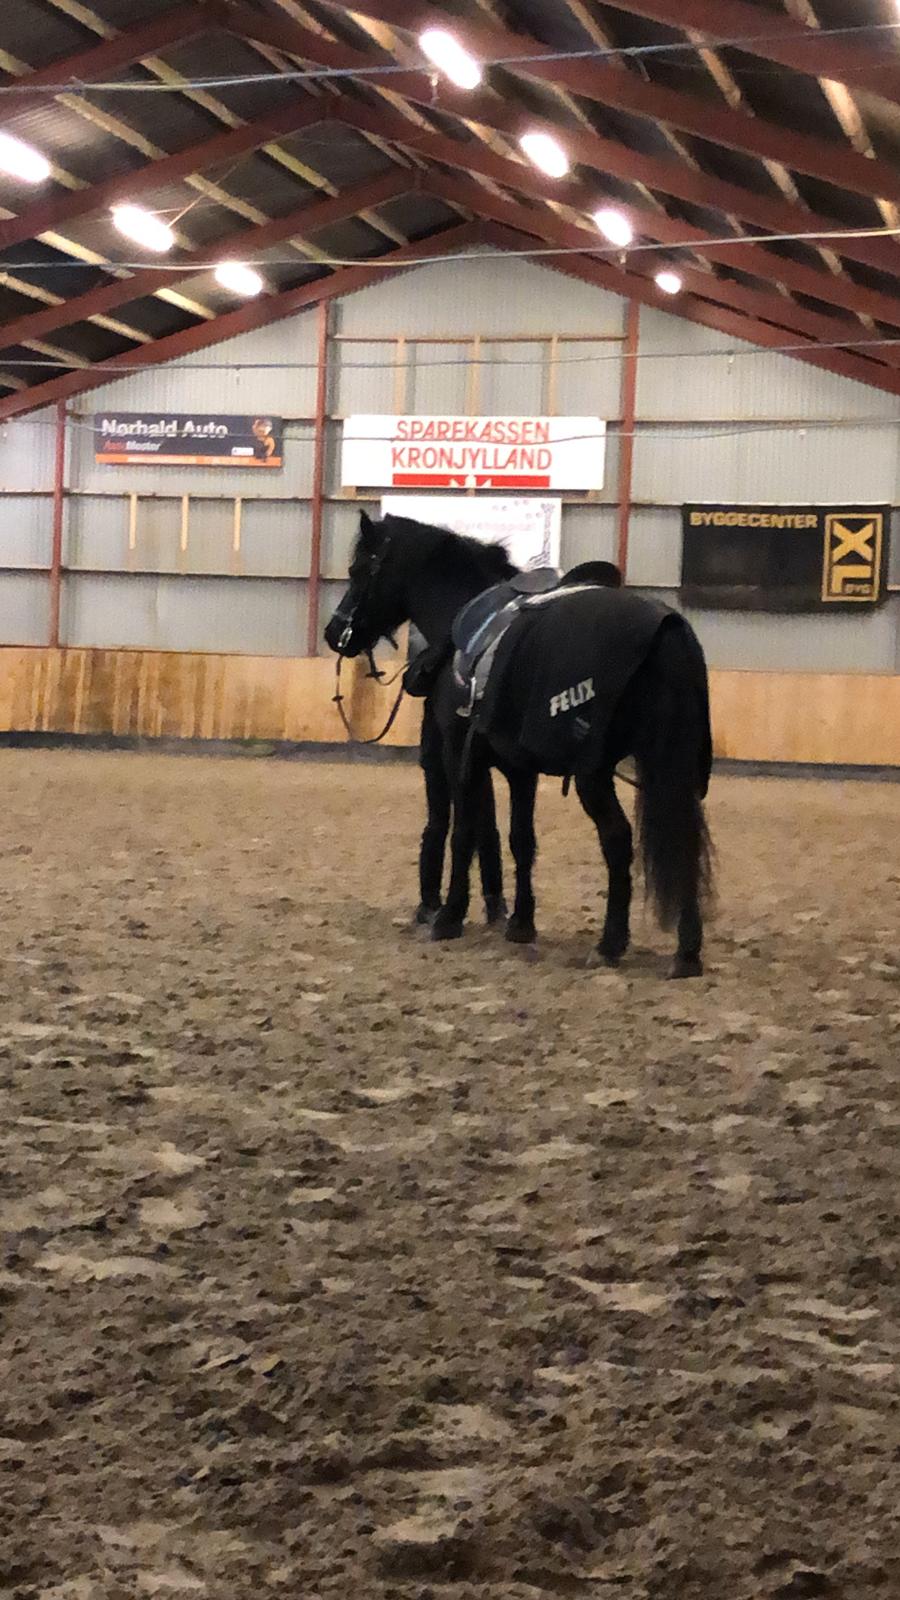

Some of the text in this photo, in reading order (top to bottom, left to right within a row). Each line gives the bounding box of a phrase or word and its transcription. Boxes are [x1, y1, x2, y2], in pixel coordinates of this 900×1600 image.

[181, 419, 229, 439] Auto
[395, 420, 550, 444] SPAREKASSEN
[391, 447, 552, 470] KRONJYLLAND
[689, 511, 818, 529] BYGGECENTER
[549, 677, 596, 717] FELIX
